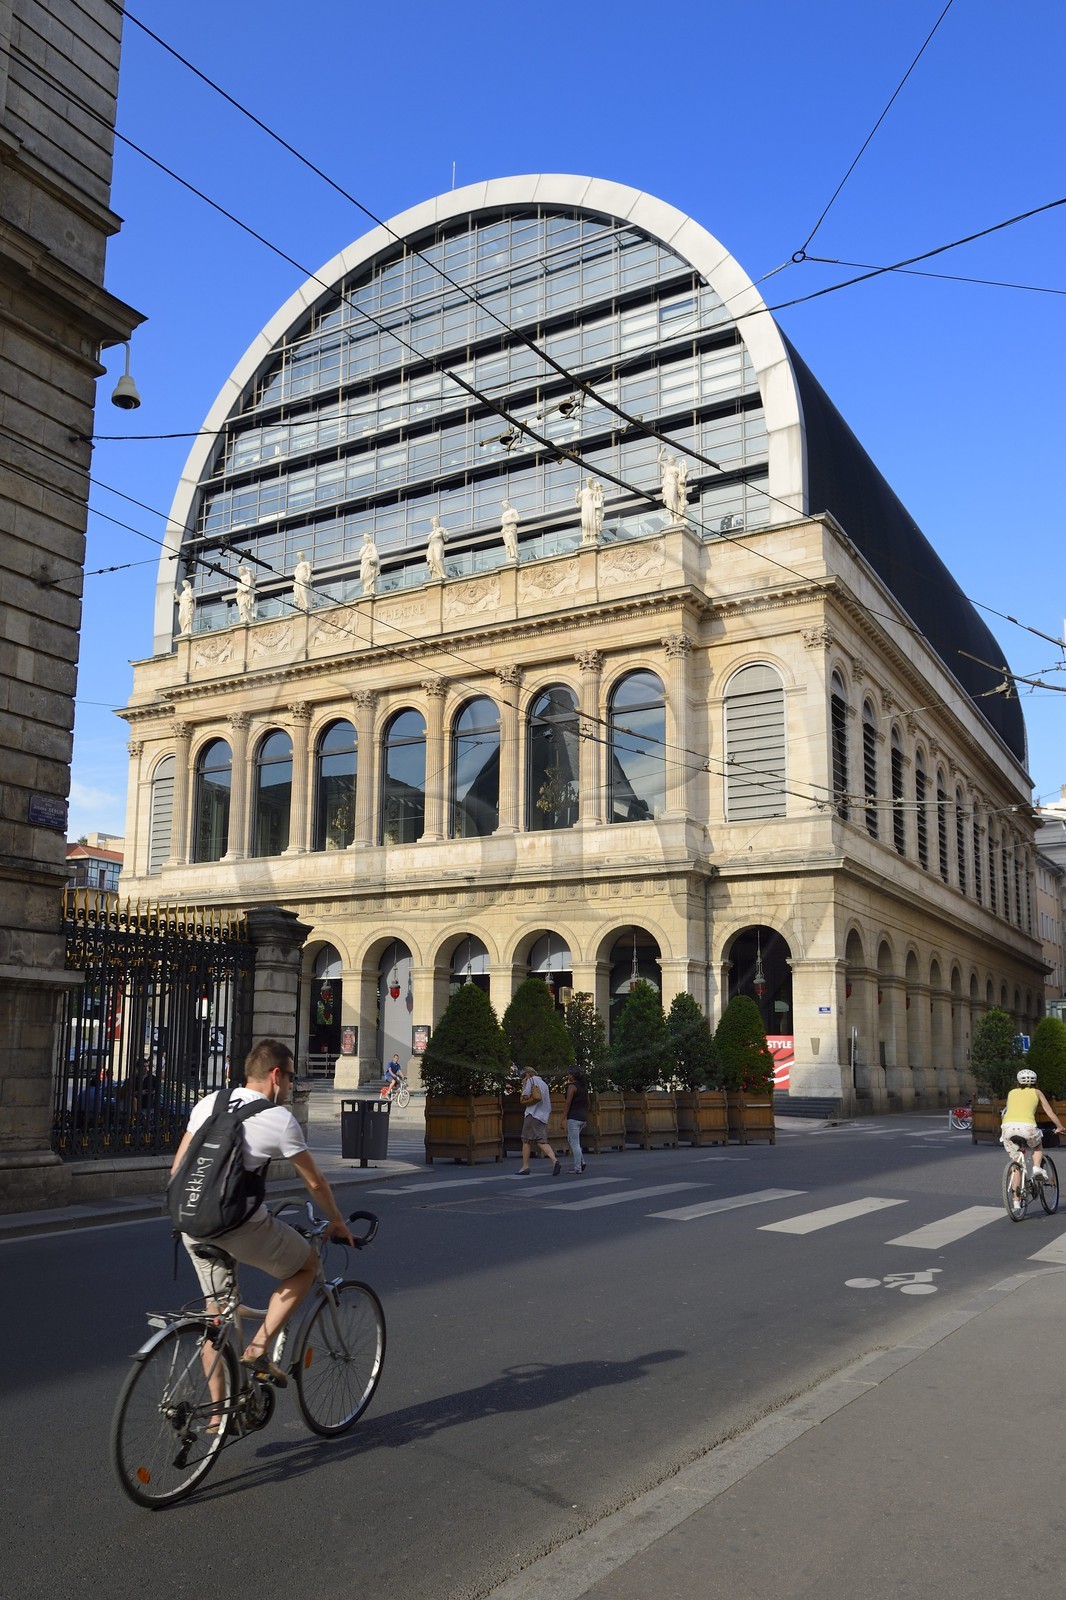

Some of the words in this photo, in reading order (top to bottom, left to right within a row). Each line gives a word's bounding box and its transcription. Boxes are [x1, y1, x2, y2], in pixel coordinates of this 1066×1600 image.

[378, 603, 425, 622] THEATRE
[767, 1040, 792, 1049] STYLE
[179, 1157, 213, 1222] Trekking
